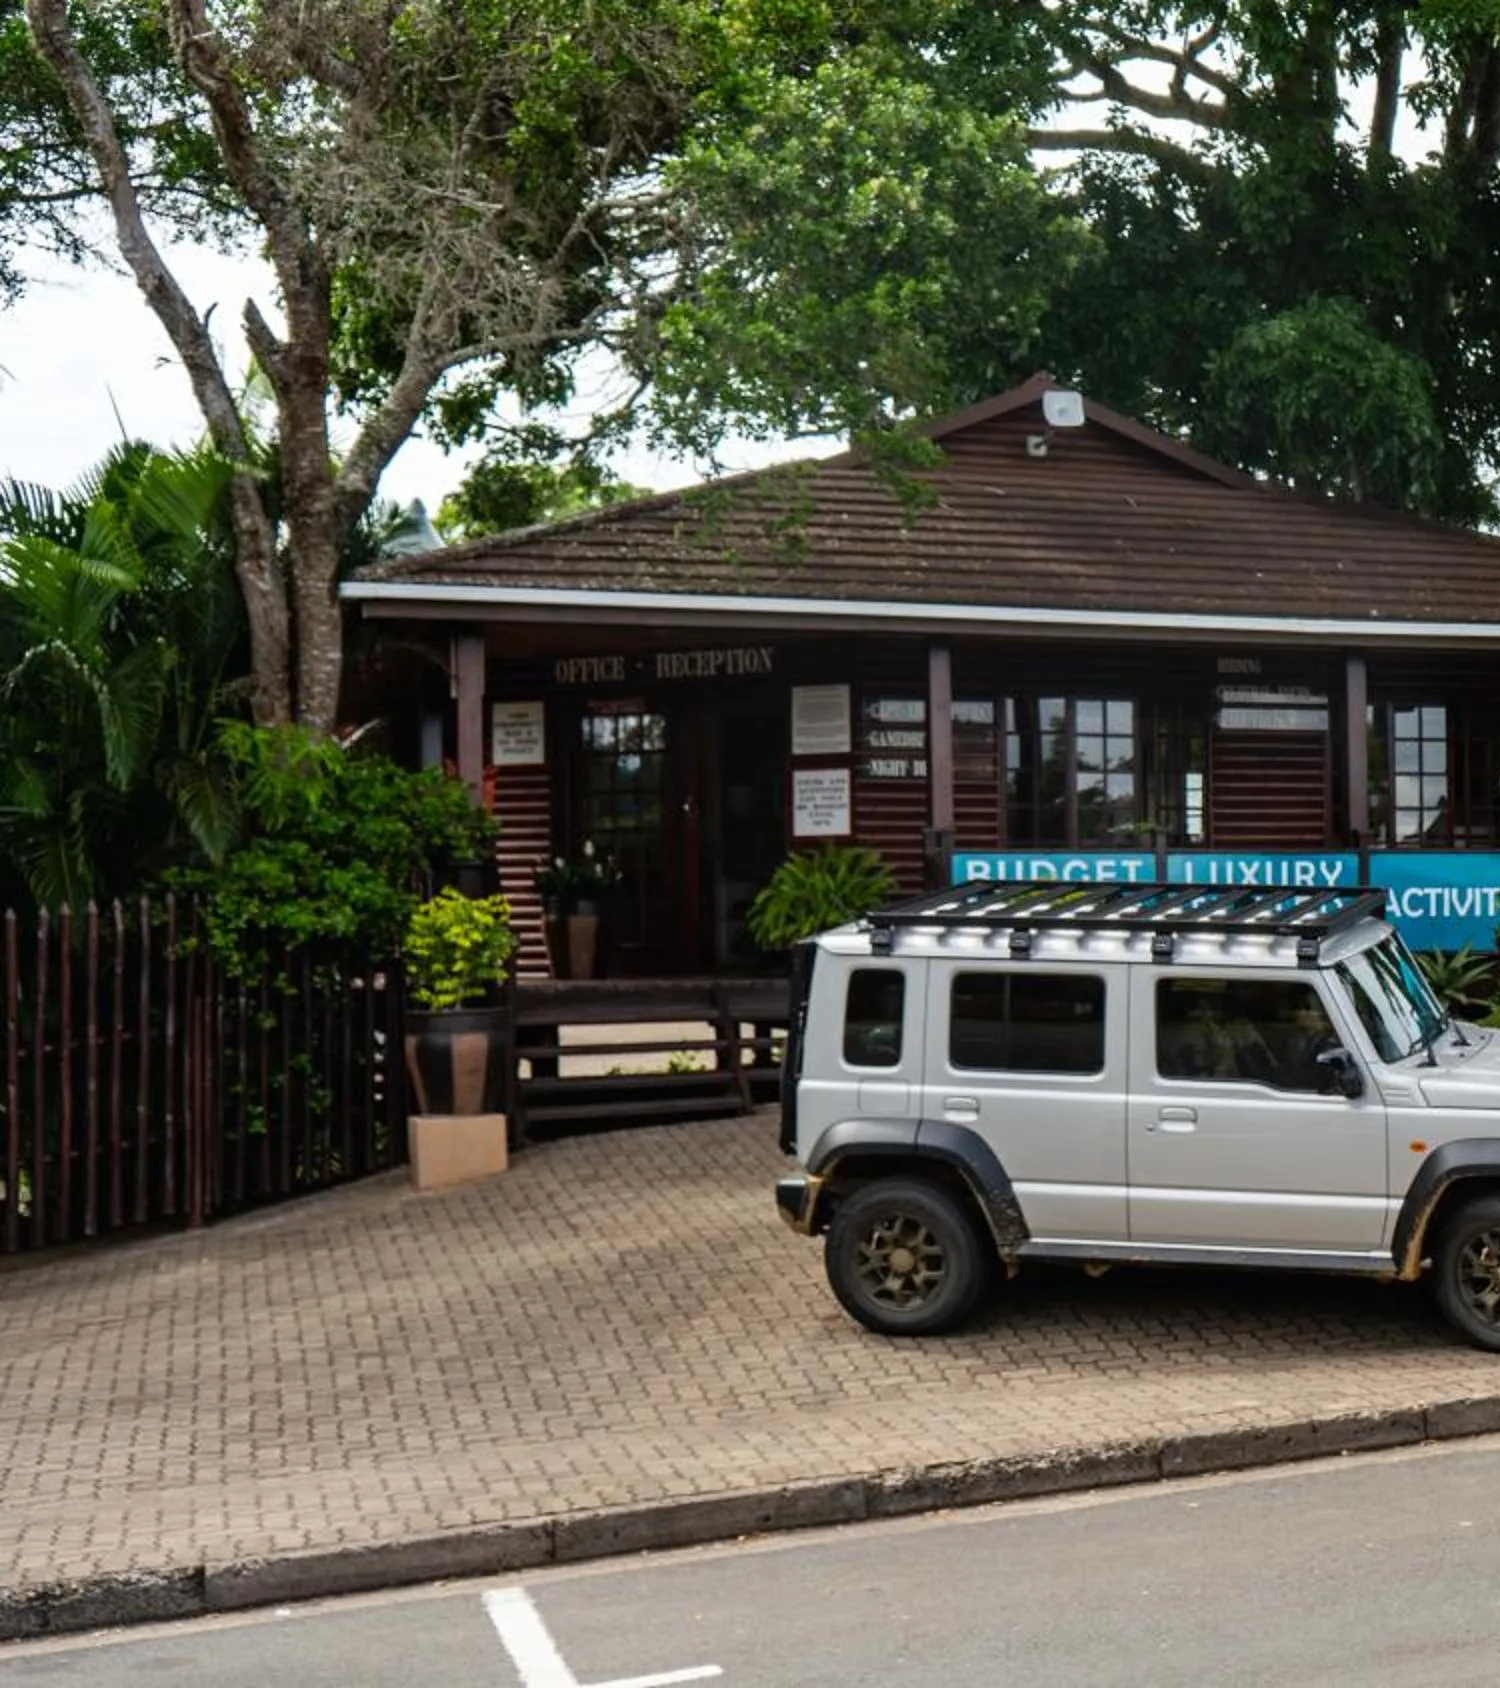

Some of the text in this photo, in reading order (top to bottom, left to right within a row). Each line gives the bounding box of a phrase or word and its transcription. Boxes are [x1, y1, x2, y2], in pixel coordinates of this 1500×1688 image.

[554, 646, 774, 684] OFFICE RECEPTION
[966, 859, 1143, 882] BUDGET
